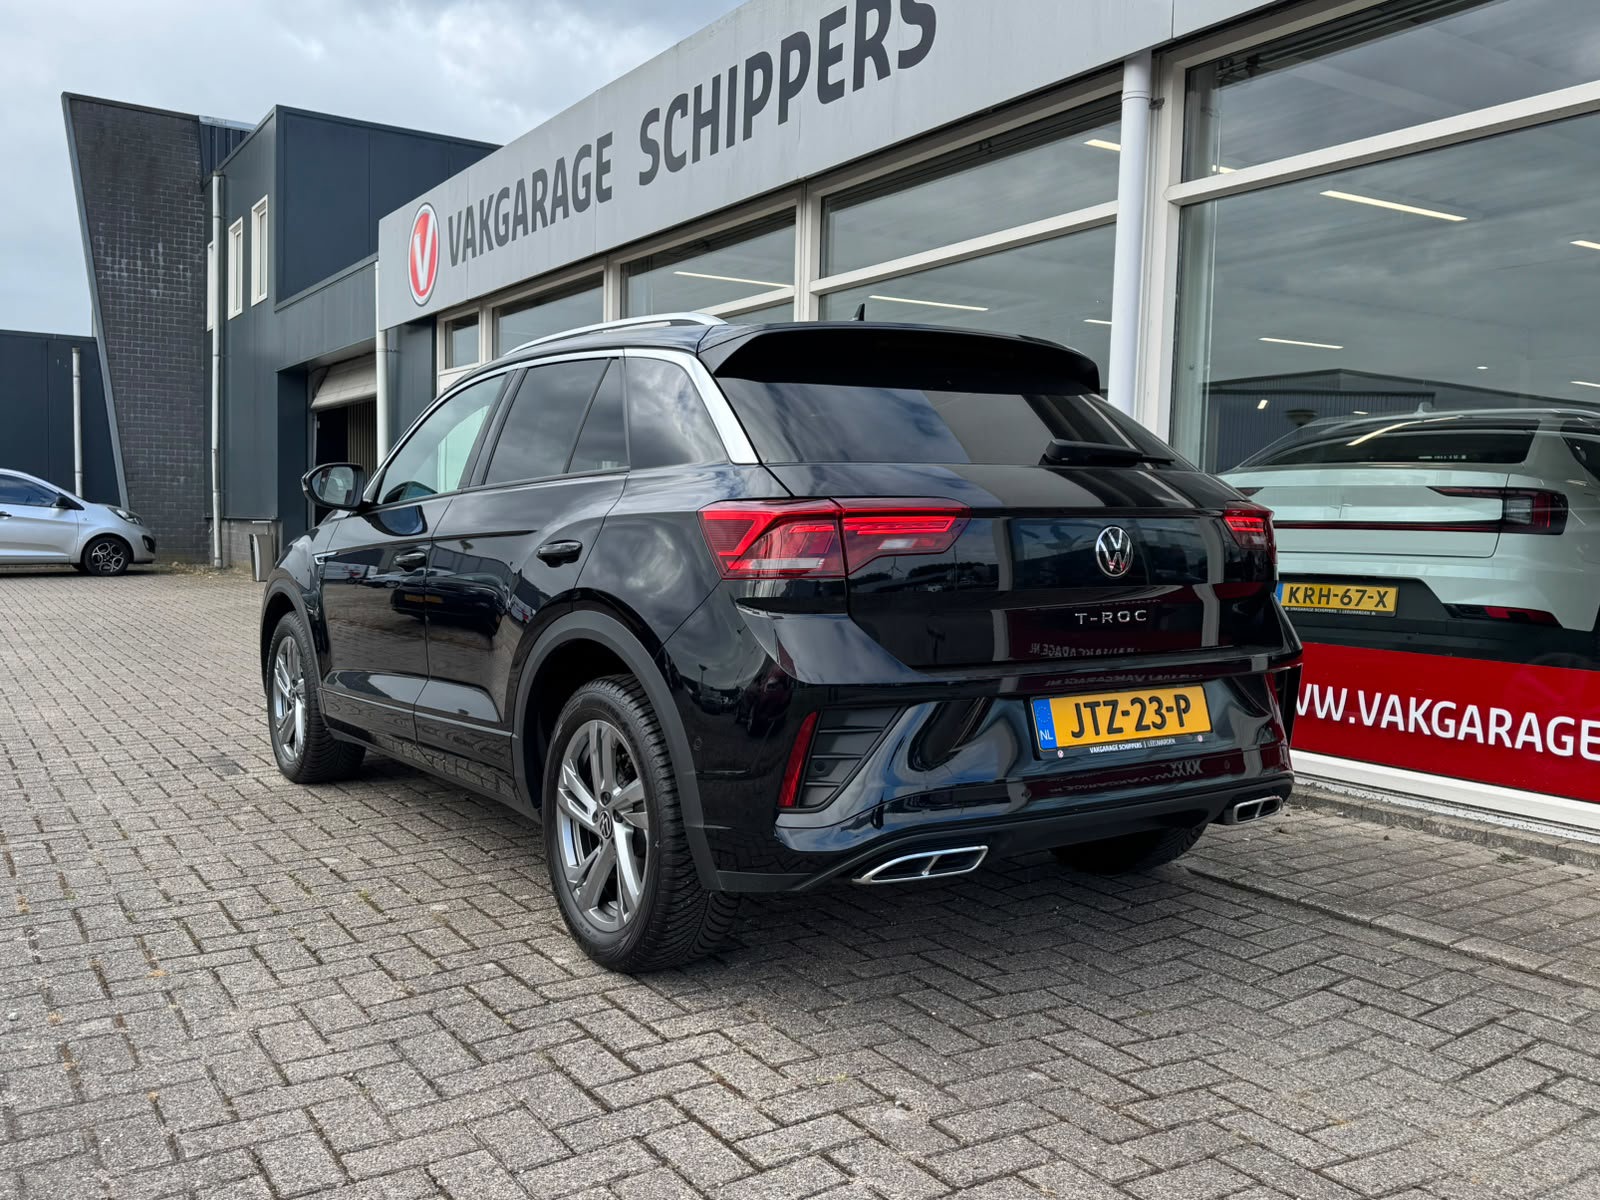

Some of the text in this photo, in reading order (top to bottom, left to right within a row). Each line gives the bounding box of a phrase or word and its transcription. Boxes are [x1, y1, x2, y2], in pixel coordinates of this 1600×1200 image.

[447, 0, 937, 268] VAKGARAGE SCHIPPERS
[1287, 586, 1389, 609] KRH-67-X
[1074, 609, 1147, 625] T-ROC
[1071, 694, 1191, 739] JTZ-23-P
[1039, 730, 1054, 741] NL
[1089, 744, 1119, 754] VAKGARAGE
